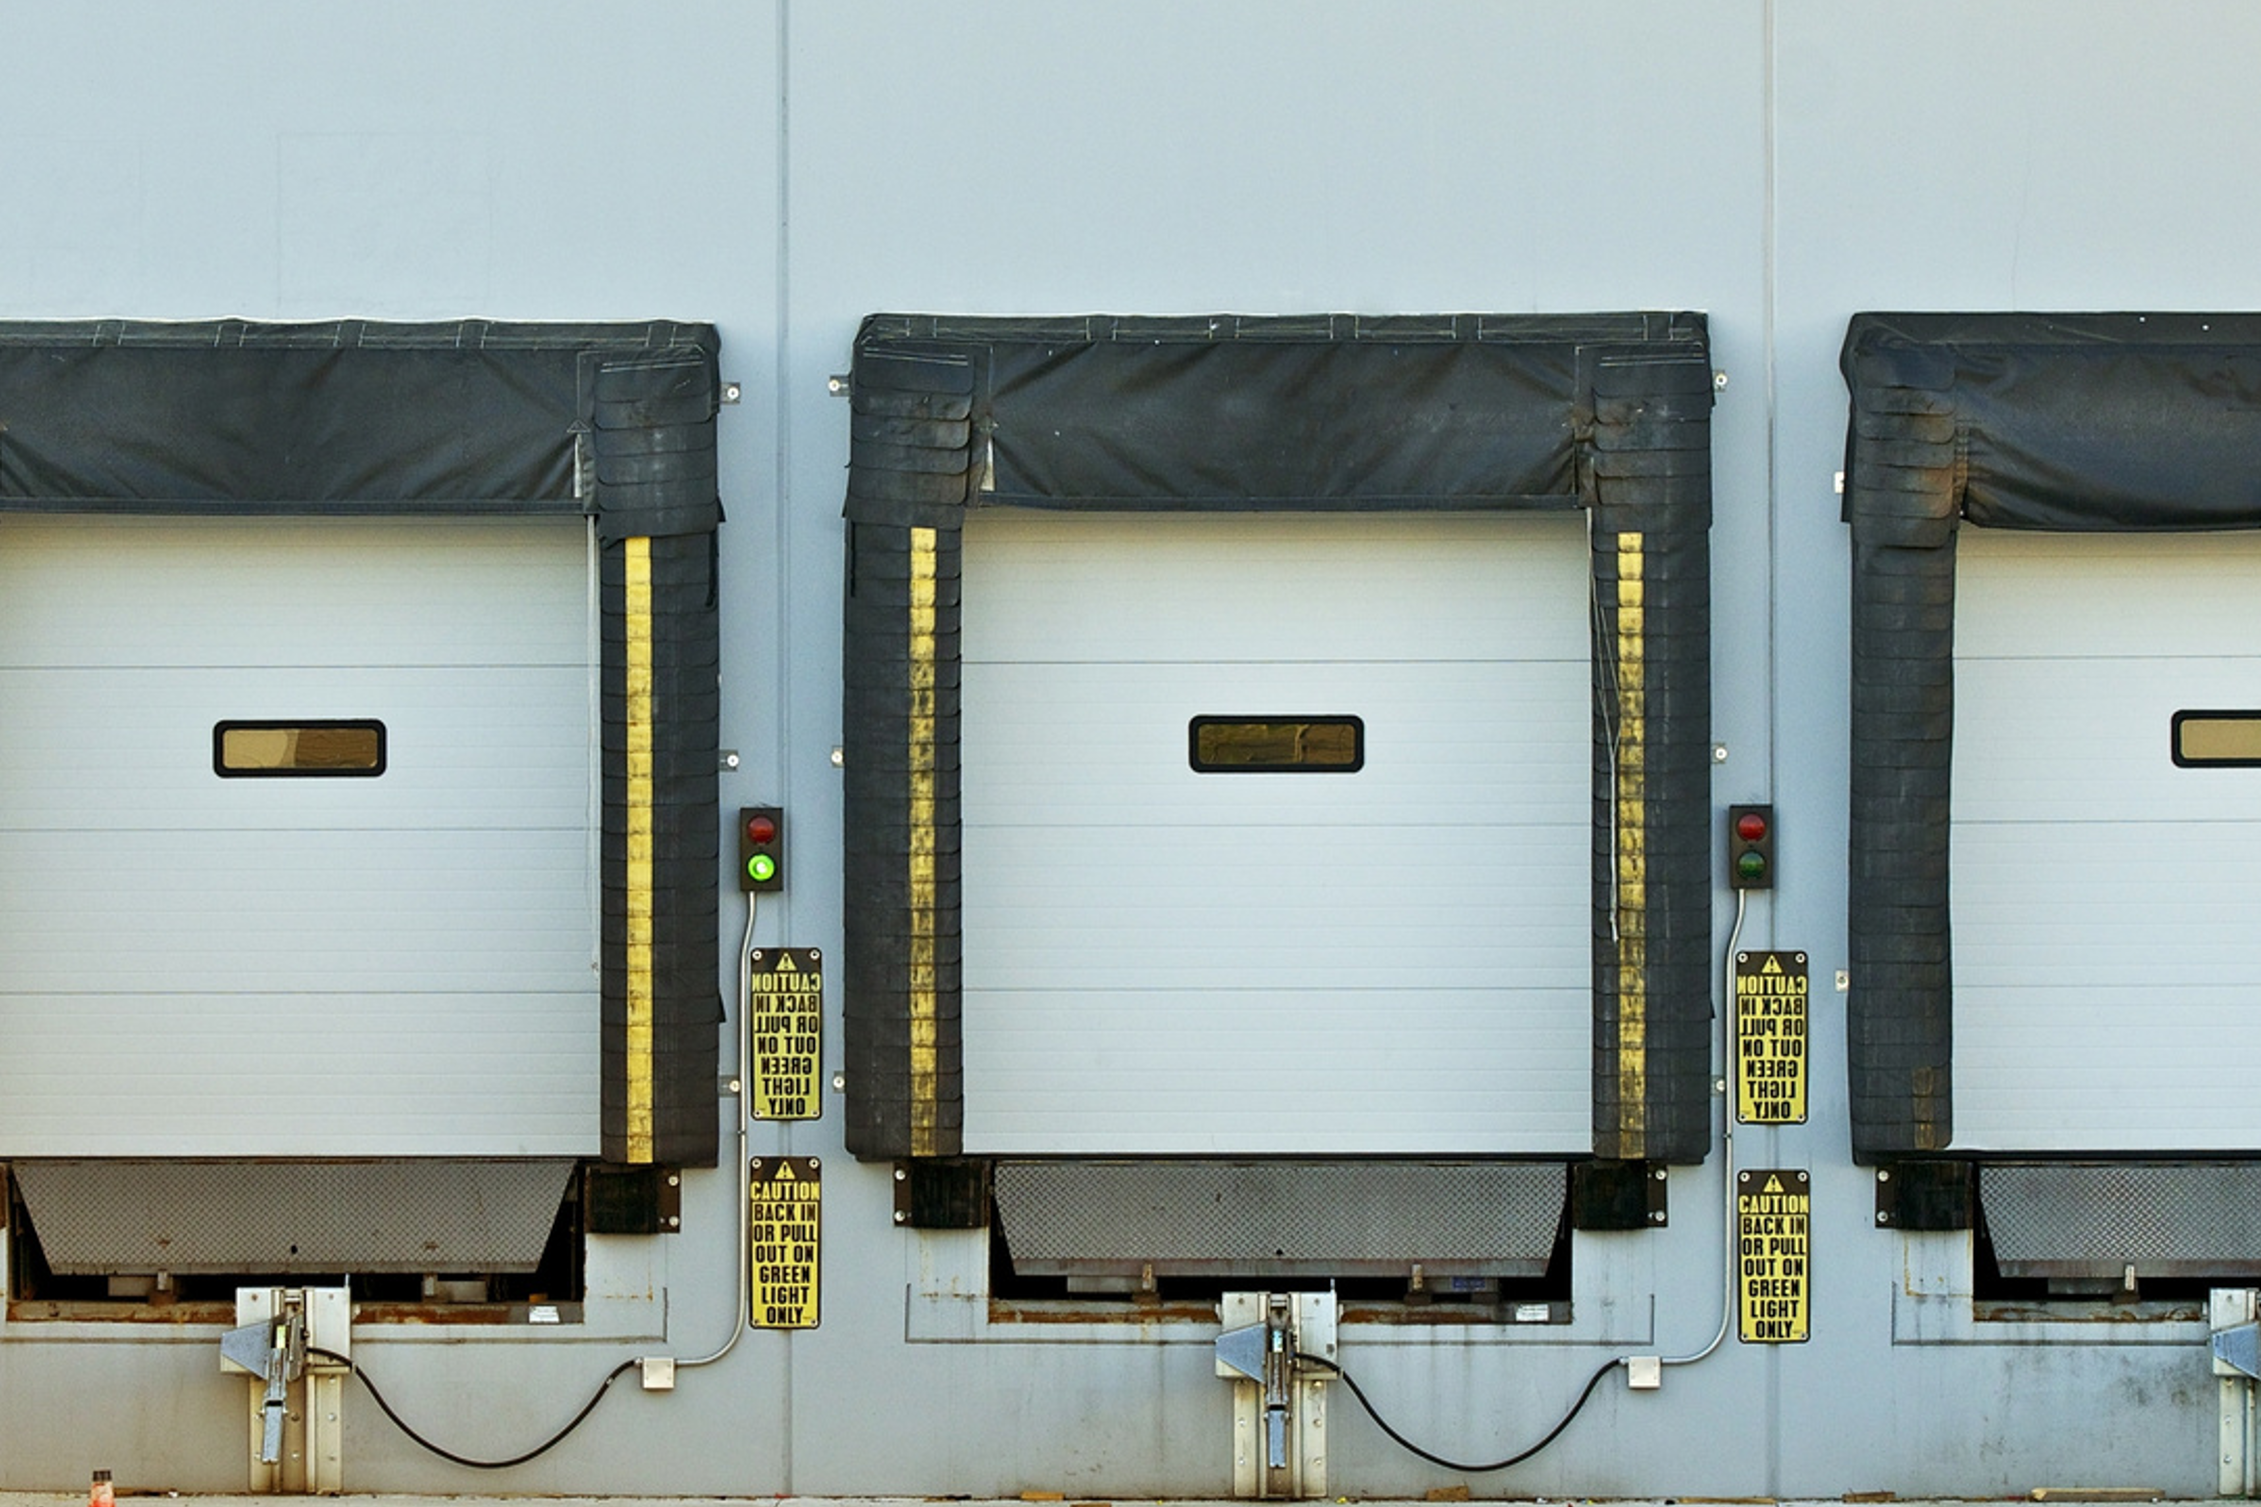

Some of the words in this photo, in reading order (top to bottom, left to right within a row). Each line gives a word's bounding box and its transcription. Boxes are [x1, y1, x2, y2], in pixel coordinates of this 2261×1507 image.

[751, 1181, 820, 1200] CAUTION
[754, 1204, 795, 1221] BACK
[801, 1204, 815, 1221] IN
[1739, 1195, 1808, 1213] CAUTION
[754, 1224, 774, 1242] OR
[781, 1224, 816, 1242] PULL
[1743, 1217, 1784, 1235] BACK
[1790, 1217, 1804, 1235] IN
[755, 1245, 787, 1263] OUT
[793, 1245, 813, 1263] ON
[1742, 1238, 1763, 1256] OR
[1770, 1238, 1805, 1256] PULL
[760, 1265, 810, 1283] GREEN
[1744, 1259, 1776, 1276] OUT
[1783, 1259, 1803, 1276] ON
[762, 1286, 809, 1304] LIGHT
[1749, 1279, 1799, 1297] GREEN
[766, 1307, 803, 1323] ONLY
[1751, 1300, 1799, 1318] LIGHT
[1756, 1321, 1793, 1338] ONLY
